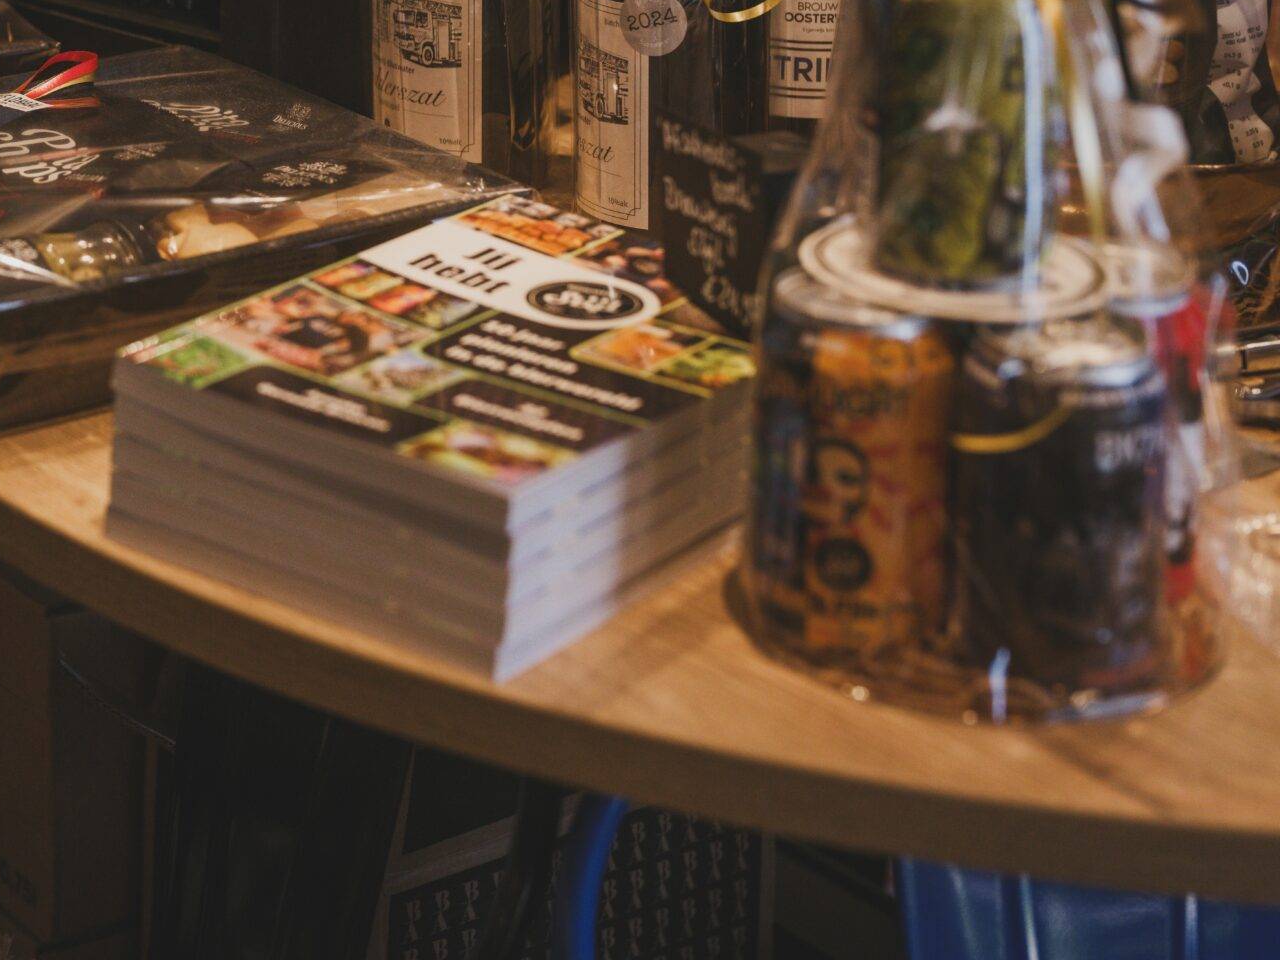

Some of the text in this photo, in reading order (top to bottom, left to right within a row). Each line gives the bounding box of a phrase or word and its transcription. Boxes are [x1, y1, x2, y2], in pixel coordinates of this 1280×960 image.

[797, 1, 839, 13] BROUW
[626, 6, 679, 32] 2024
[784, 12, 838, 24] OOSTER
[408, 253, 513, 294] hebt
